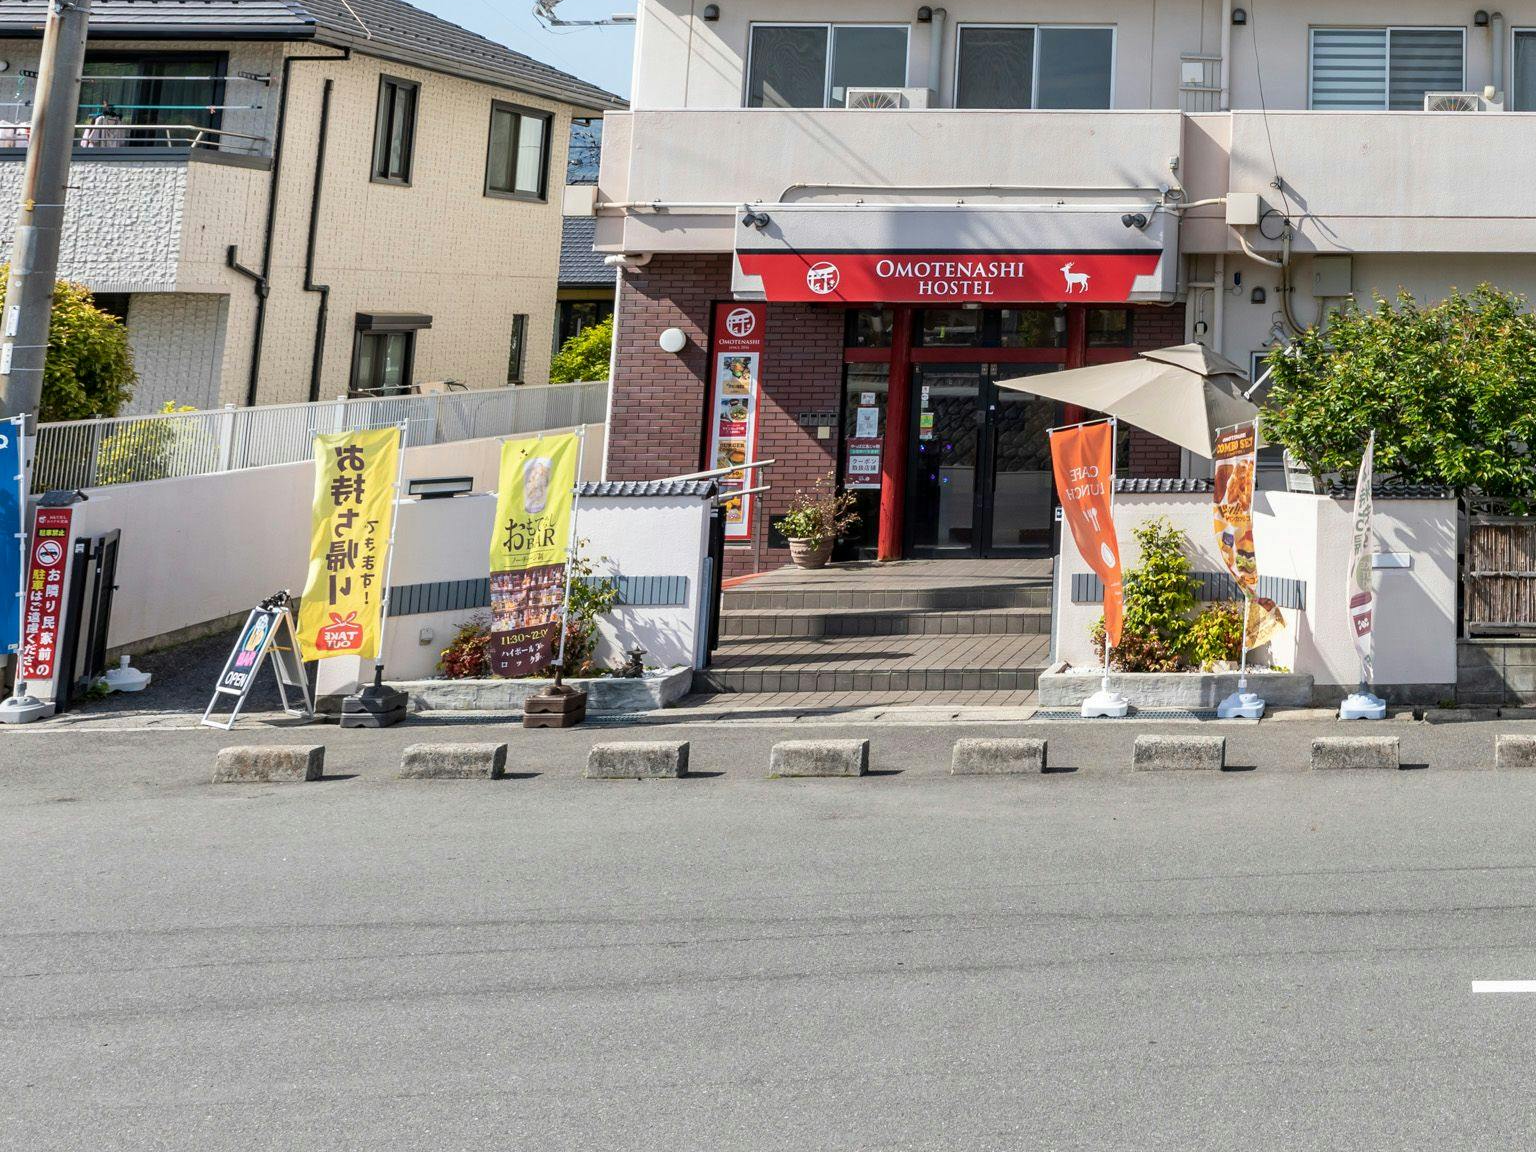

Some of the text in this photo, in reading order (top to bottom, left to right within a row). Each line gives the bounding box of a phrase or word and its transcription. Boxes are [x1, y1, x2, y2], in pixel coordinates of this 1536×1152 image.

[875, 258, 1025, 279] OMOTENASHI
[918, 280, 994, 296] HOSTEL
[225, 671, 249, 687] OPEN
